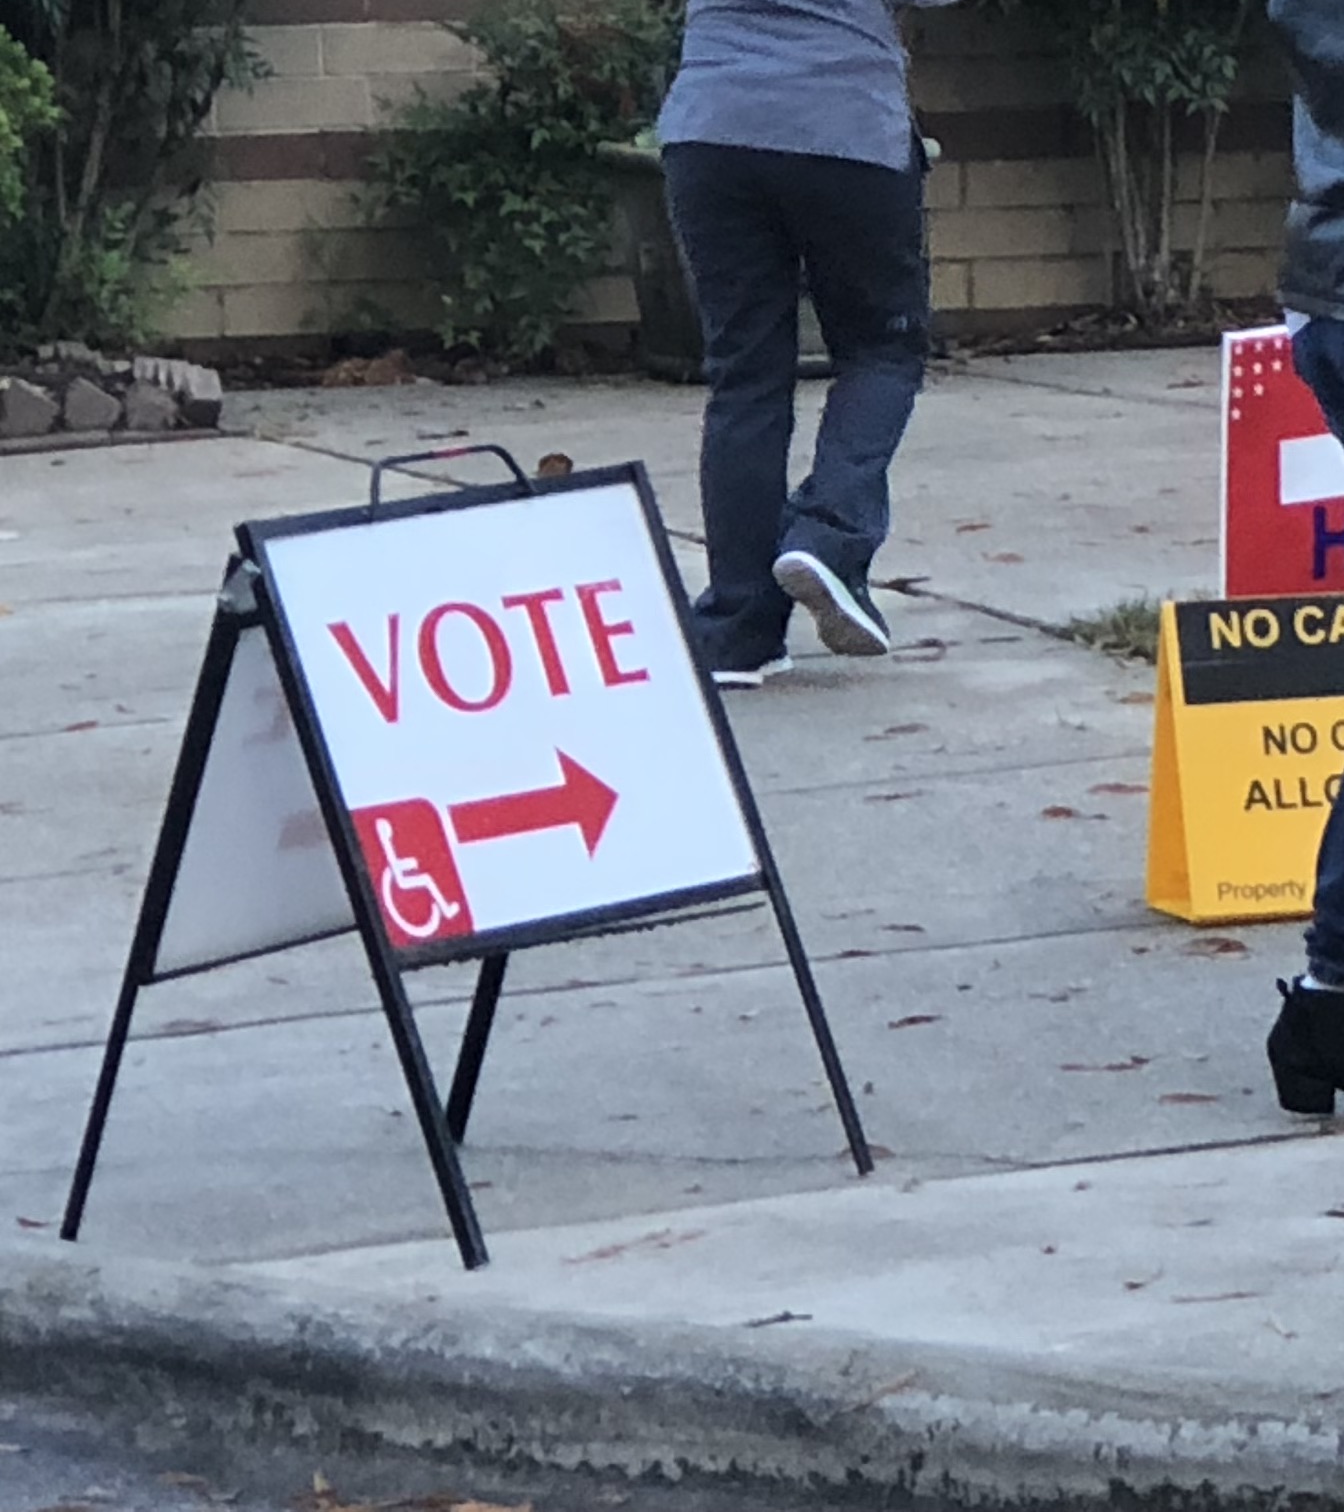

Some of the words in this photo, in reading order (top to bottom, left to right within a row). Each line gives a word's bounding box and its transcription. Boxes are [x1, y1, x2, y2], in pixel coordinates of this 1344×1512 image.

[1209, 608, 1280, 649] NO
[326, 578, 651, 725] VOTE
[1262, 722, 1318, 755] NO
[1244, 773, 1344, 811] ALLO
[1217, 879, 1308, 902] Property
